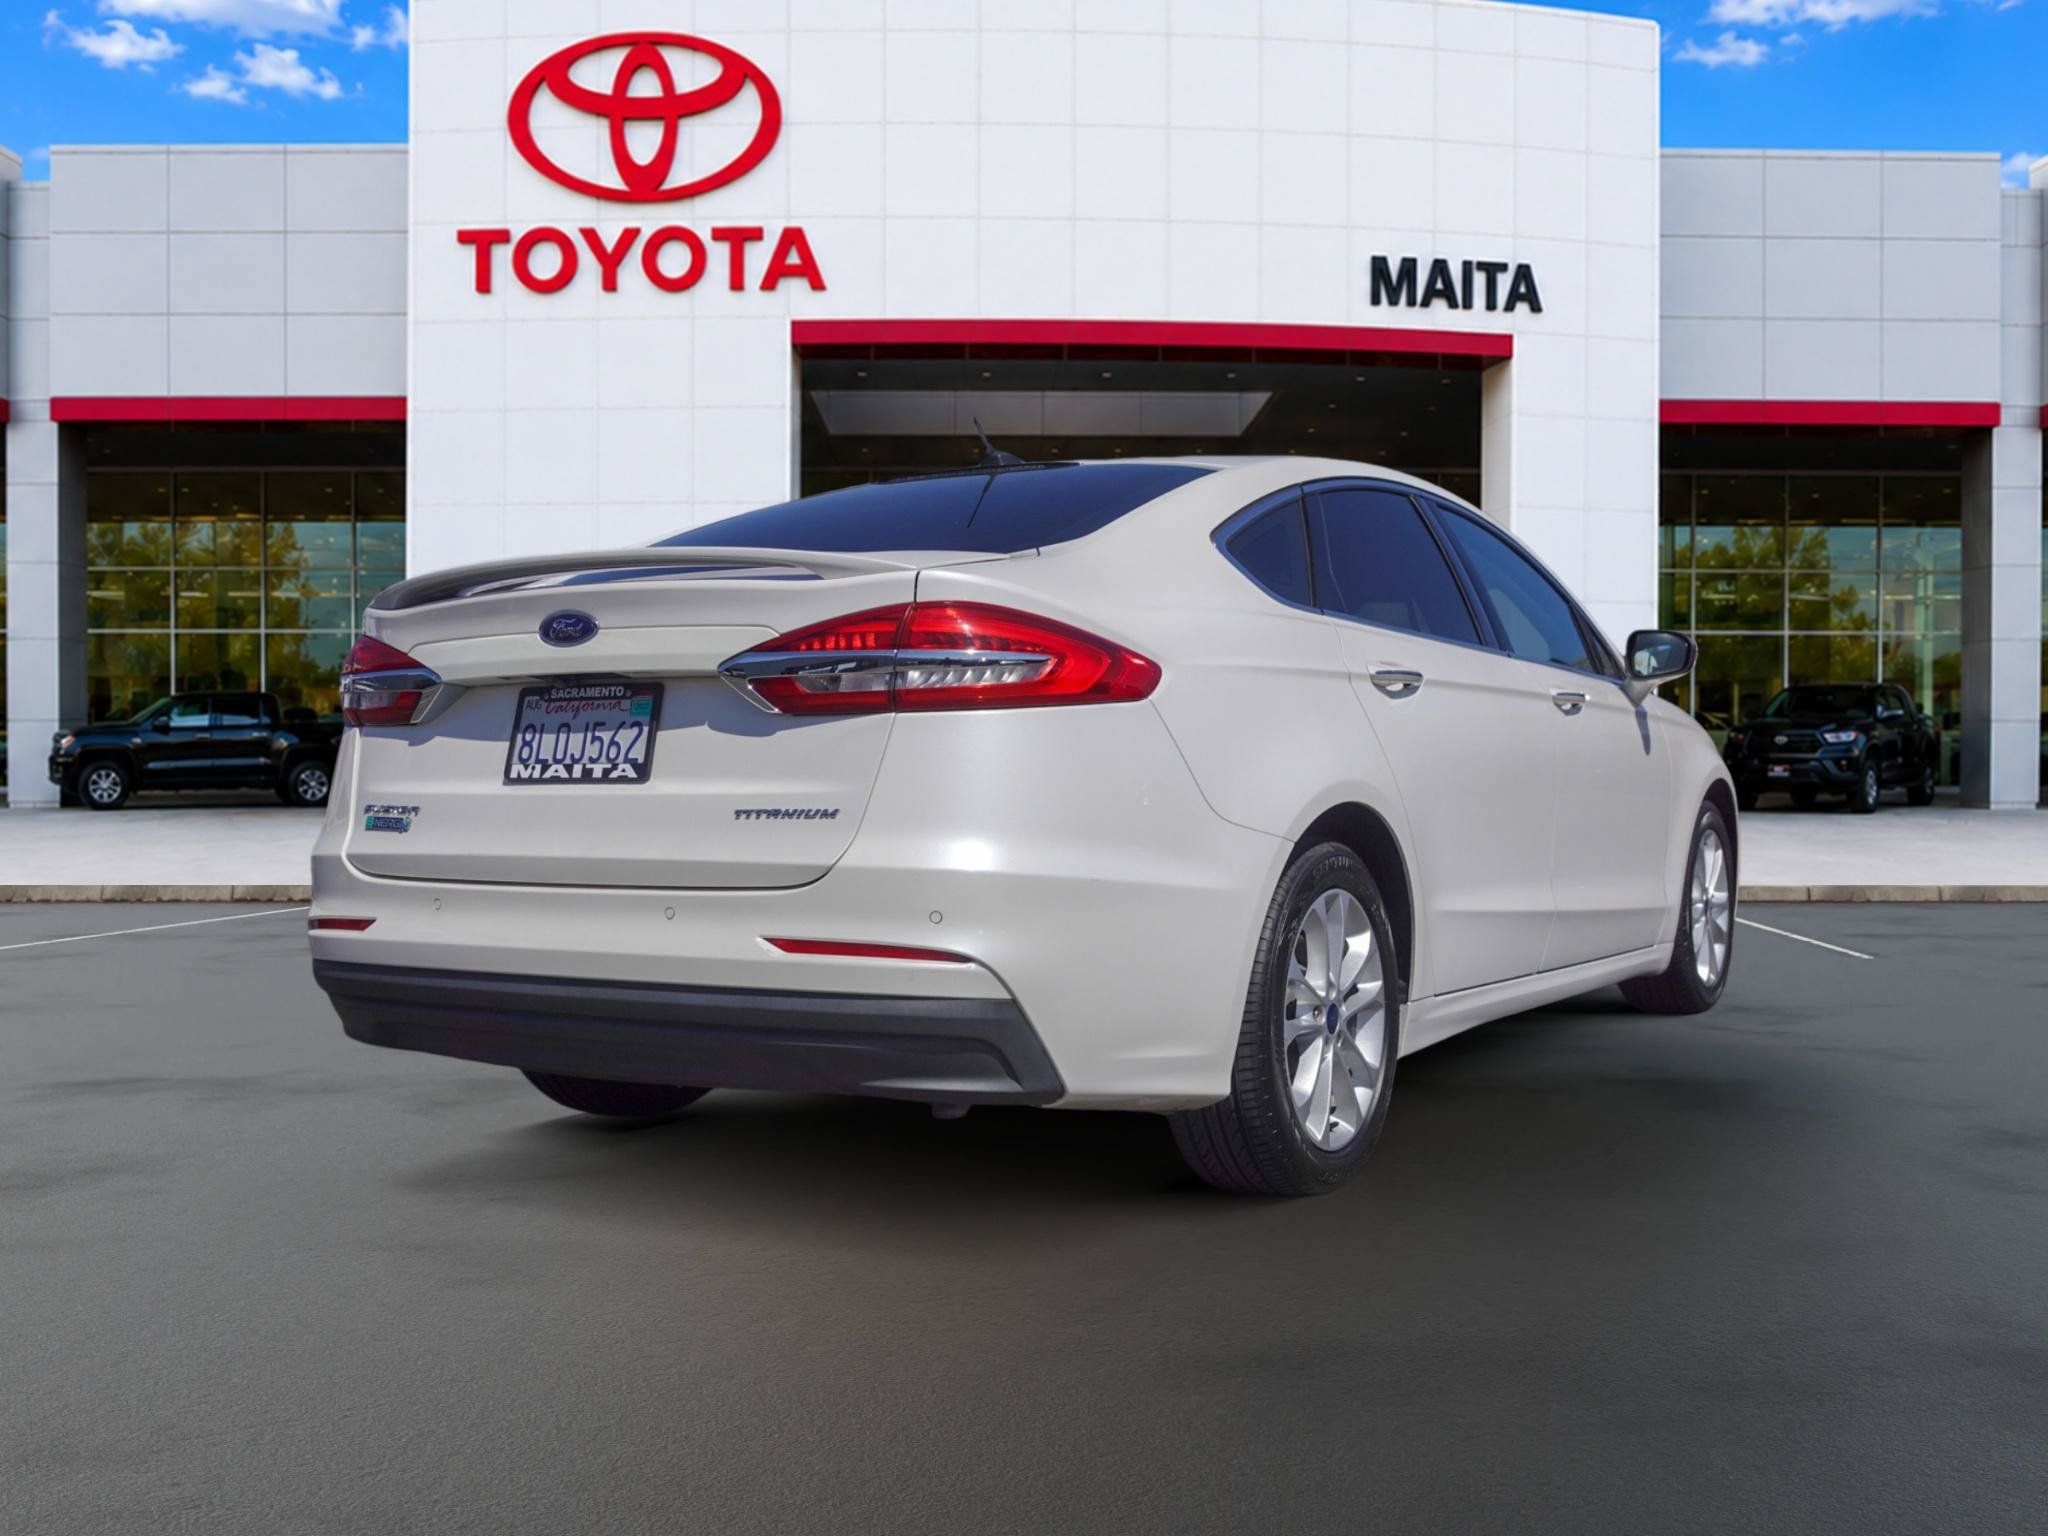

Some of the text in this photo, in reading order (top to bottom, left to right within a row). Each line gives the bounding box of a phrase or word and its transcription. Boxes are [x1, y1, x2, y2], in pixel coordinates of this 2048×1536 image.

[457, 226, 826, 294] TOYOTA
[1370, 255, 1543, 313] MAITA
[551, 687, 624, 699] SACRAMENTO
[545, 700, 630, 720] California
[509, 763, 638, 779] MAITA
[734, 808, 840, 820] TITANIUM
